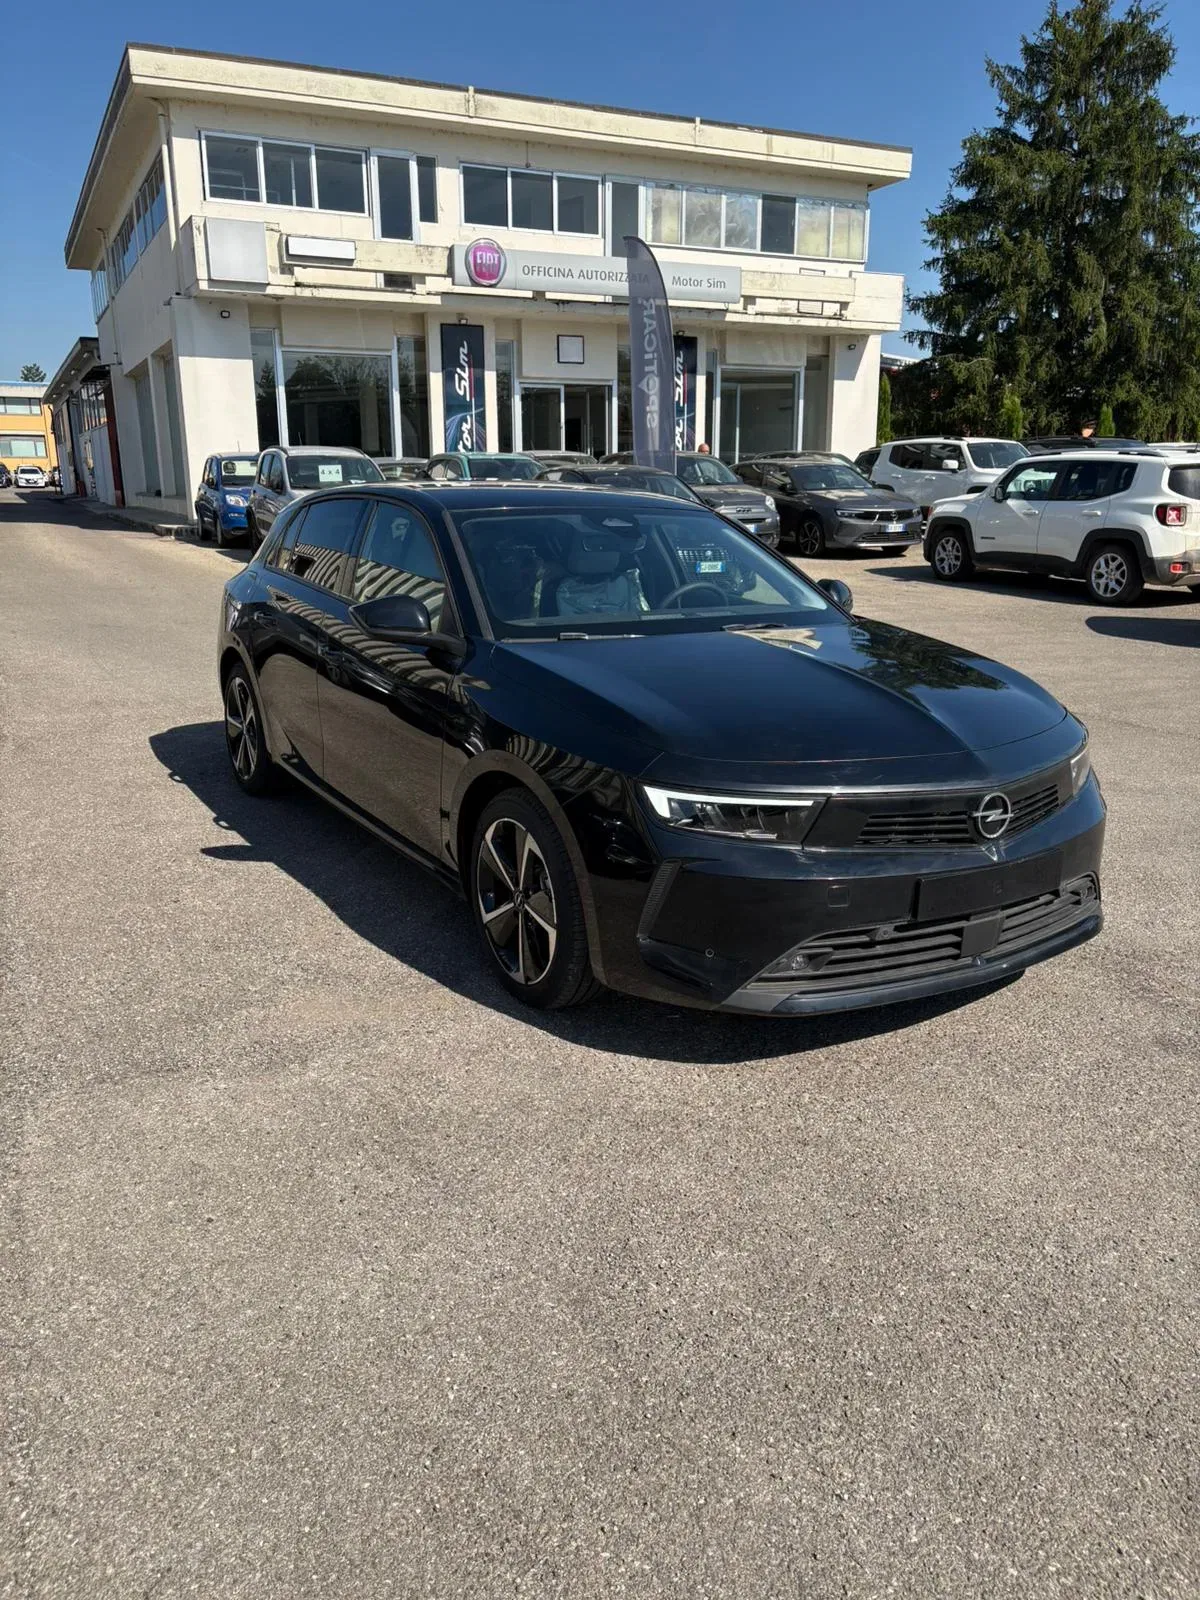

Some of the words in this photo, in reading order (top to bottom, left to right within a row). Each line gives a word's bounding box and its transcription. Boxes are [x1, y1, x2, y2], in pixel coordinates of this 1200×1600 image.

[476, 251, 499, 265] FIAT
[522, 264, 574, 279] OFFICINA
[671, 275, 703, 288] Motor
[706, 278, 726, 289] Sim
